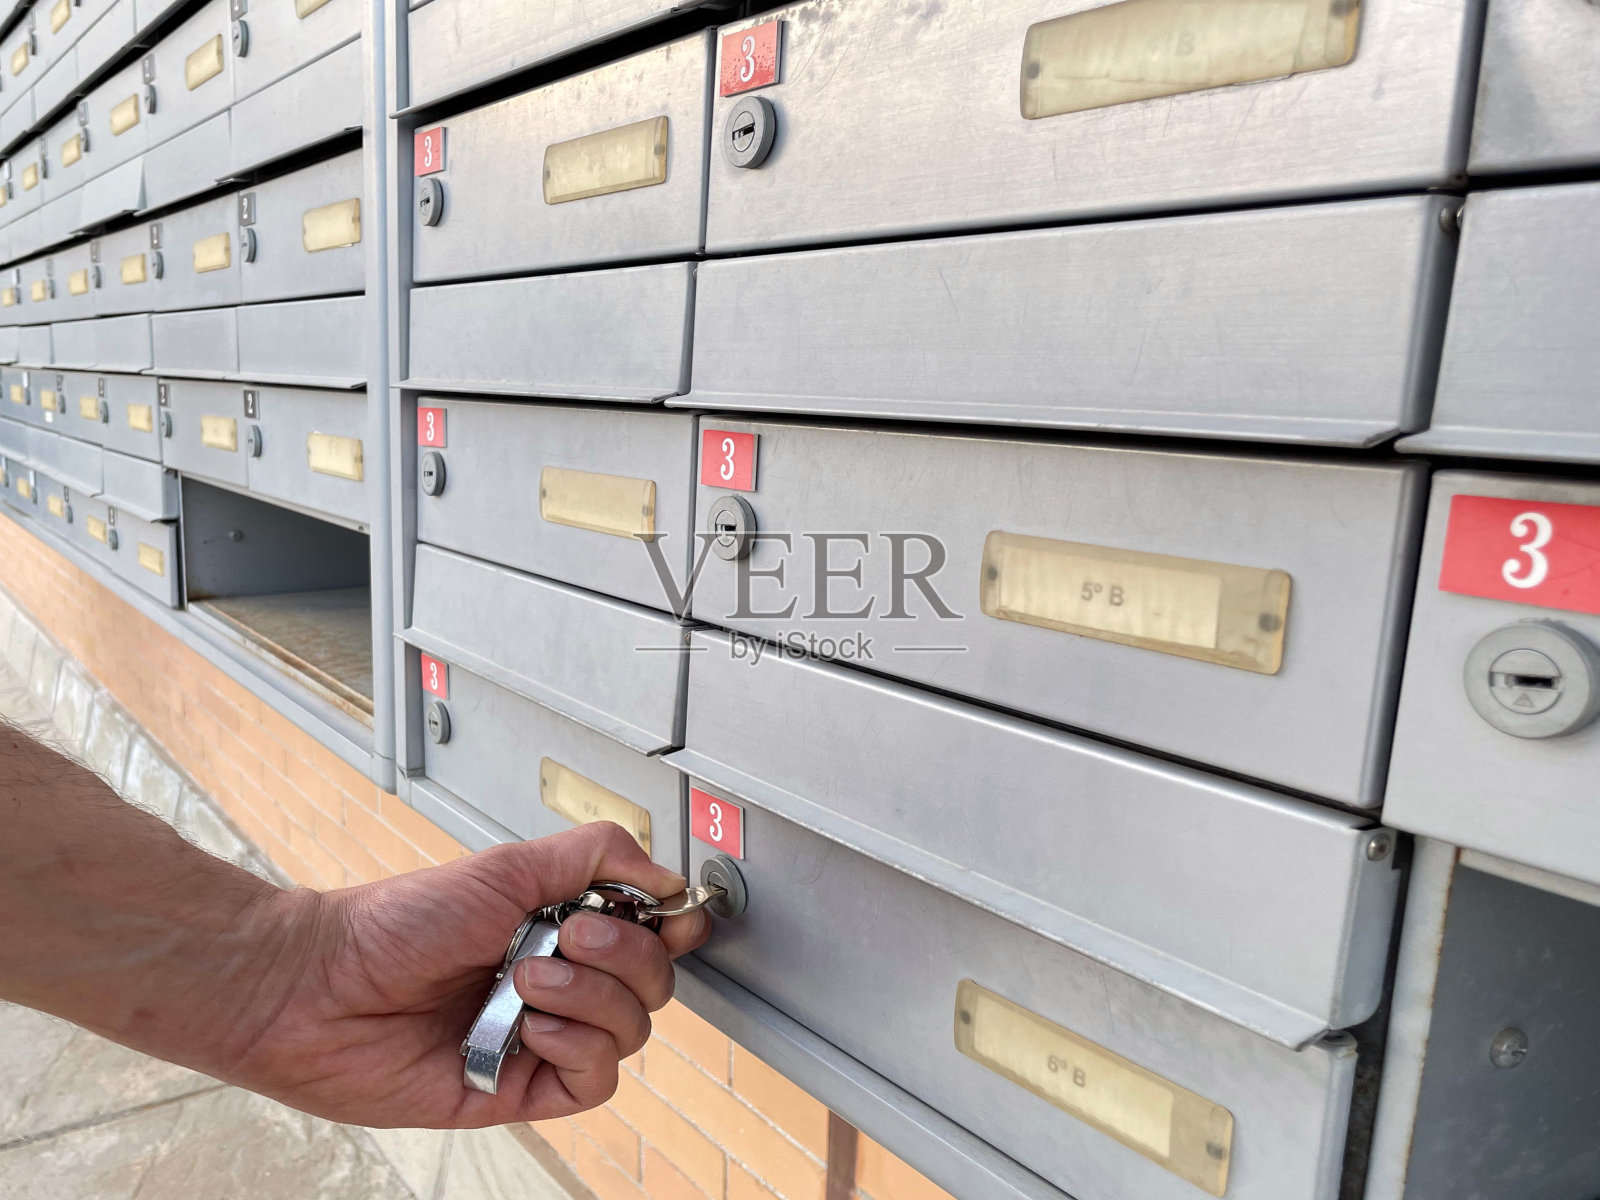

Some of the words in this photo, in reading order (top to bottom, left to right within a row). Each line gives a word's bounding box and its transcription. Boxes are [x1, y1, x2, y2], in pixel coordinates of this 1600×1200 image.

[739, 34, 757, 84] 3
[424, 135, 434, 168] 3
[247, 392, 254, 415] 2
[426, 411, 435, 442] 3
[720, 436, 736, 482] 3
[1501, 511, 1553, 589] 3
[1108, 584, 1125, 607] B
[429, 661, 438, 691] 3
[709, 802, 723, 842] 3
[1073, 1067, 1087, 1088] B
